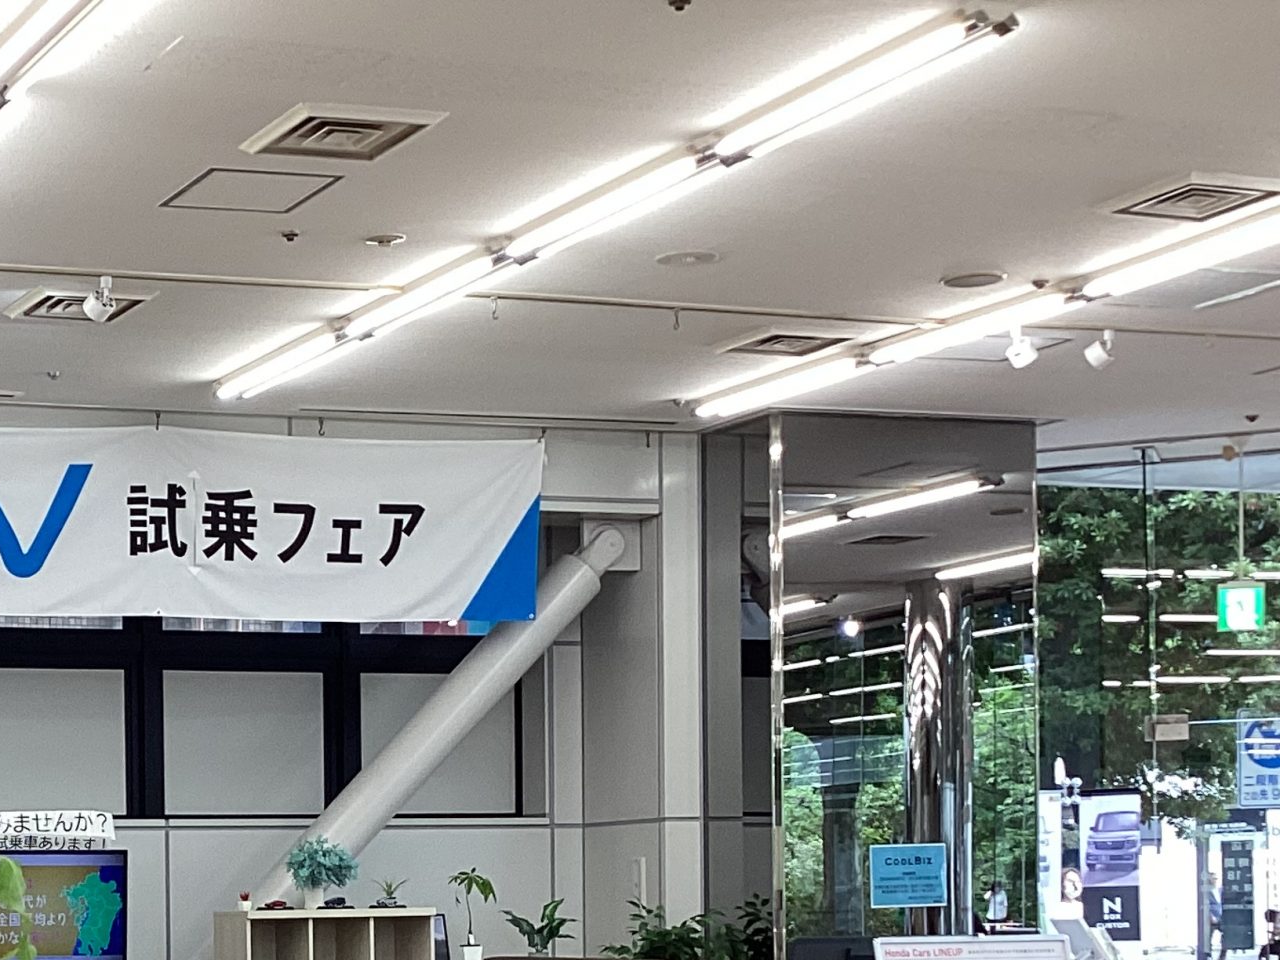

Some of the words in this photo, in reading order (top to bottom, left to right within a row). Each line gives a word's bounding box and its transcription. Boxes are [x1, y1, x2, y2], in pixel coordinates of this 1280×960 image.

[126, 482, 426, 567] 試乗フェア
[1102, 896, 1122, 914] N
[912, 948, 931, 957] Cars
[933, 947, 964, 957] LINEUP
